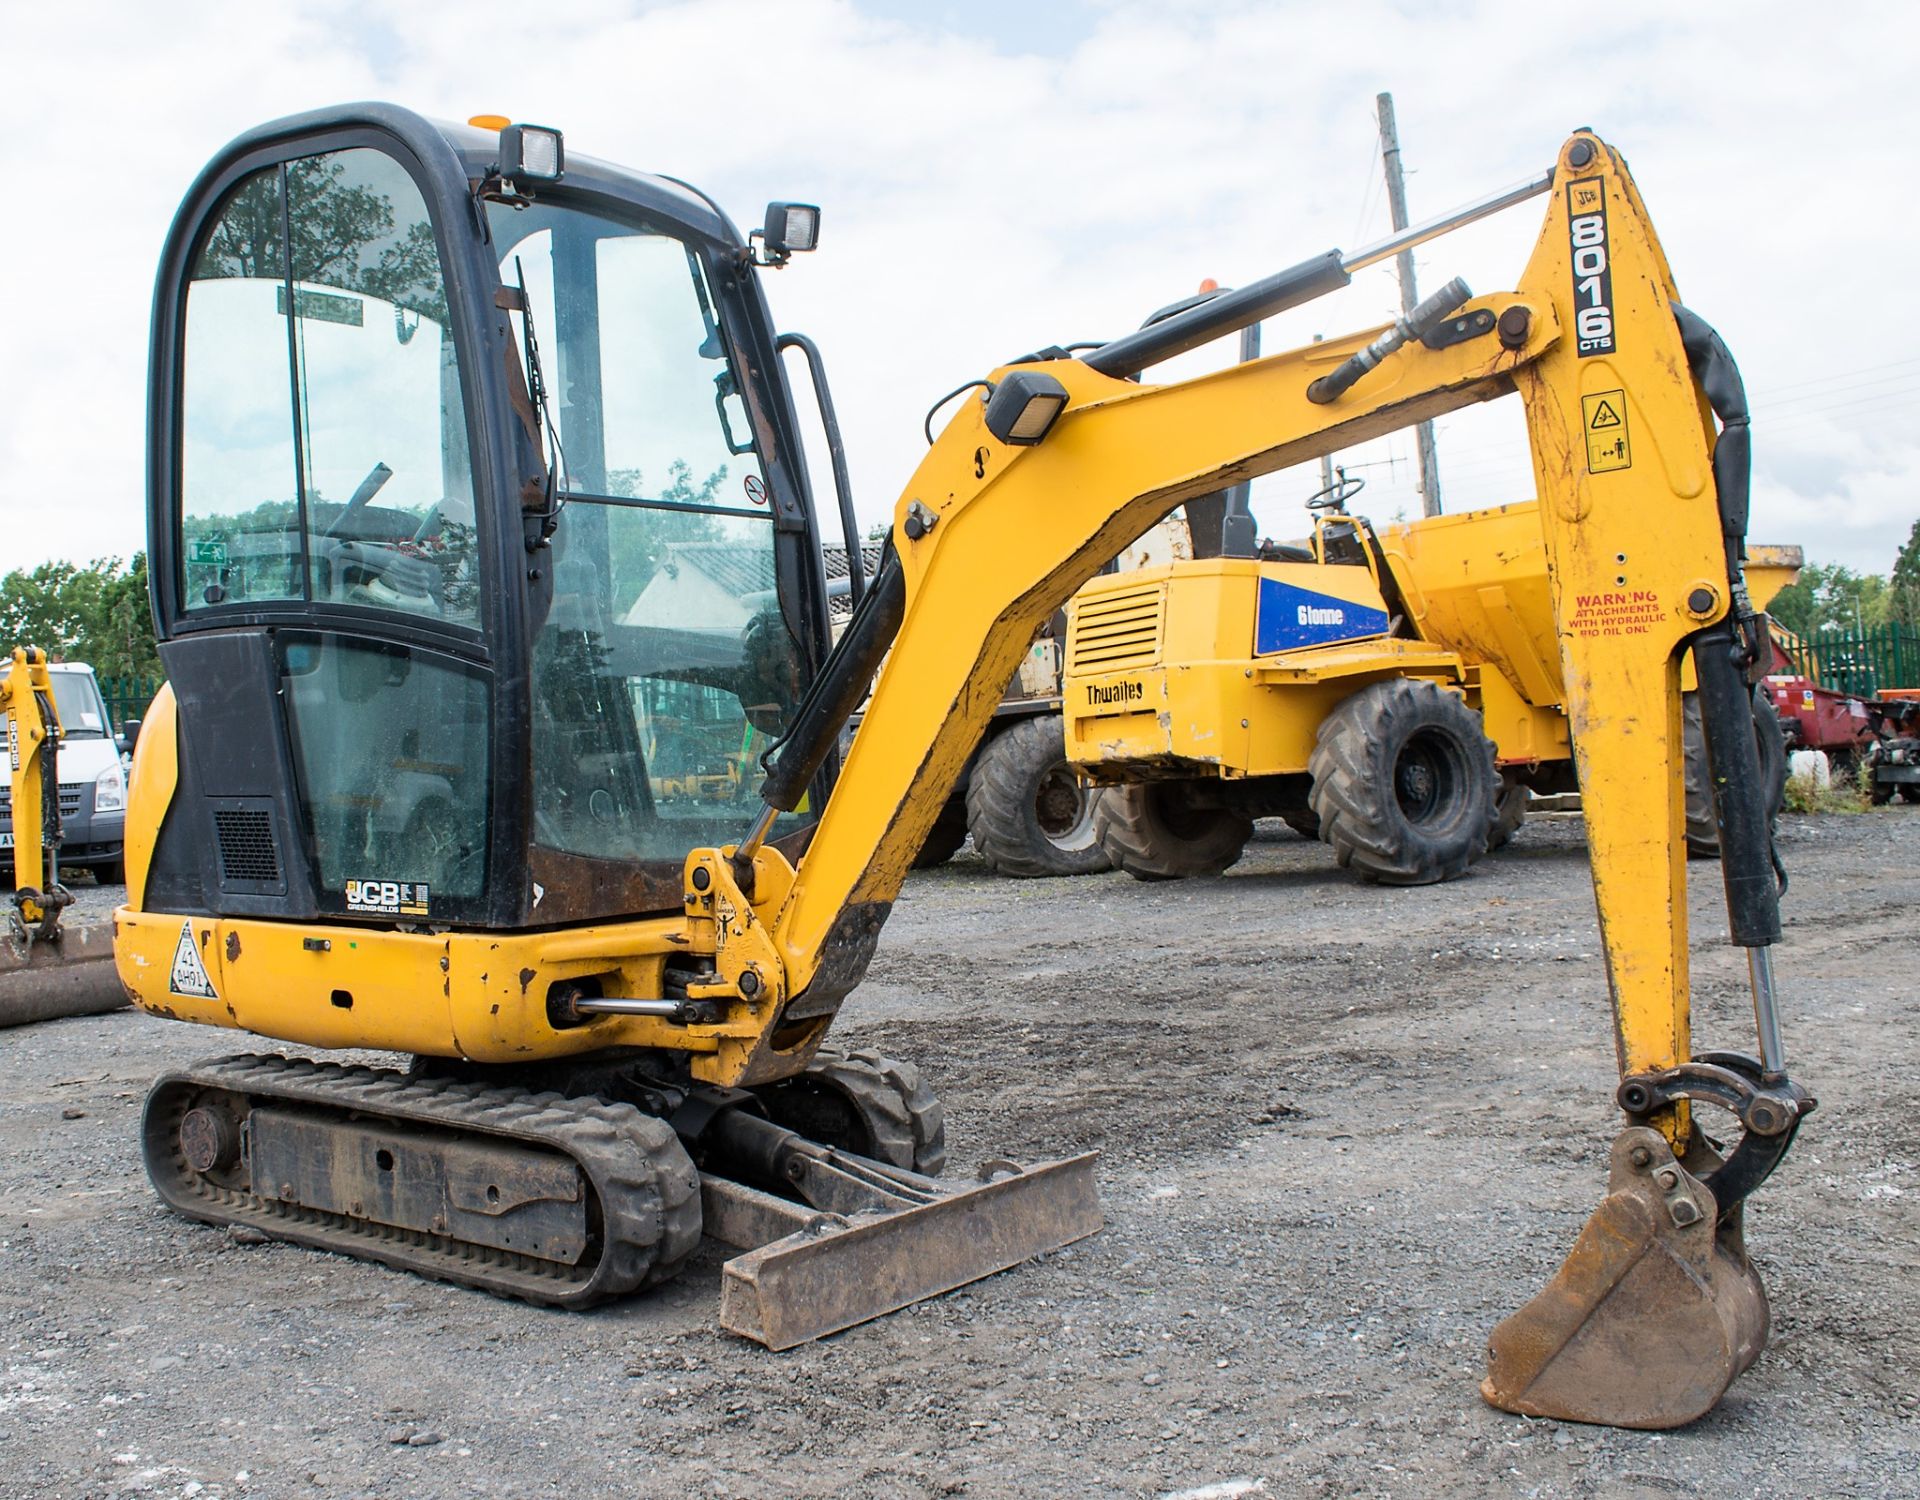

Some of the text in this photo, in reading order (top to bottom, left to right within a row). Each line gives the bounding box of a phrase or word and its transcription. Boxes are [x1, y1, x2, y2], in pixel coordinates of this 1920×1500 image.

[1577, 190, 1597, 207] JCB
[1571, 215, 1612, 339] 8016
[1579, 337, 1612, 350] CTS
[1576, 604, 1660, 618] ATTACHMENTS
[1569, 613, 1667, 628] WITH HYDRAULIC
[1603, 627, 1622, 635] OIL
[1625, 625, 1651, 635] ONL
[1086, 680, 1143, 705] Thwaites
[345, 880, 400, 906] JCB
